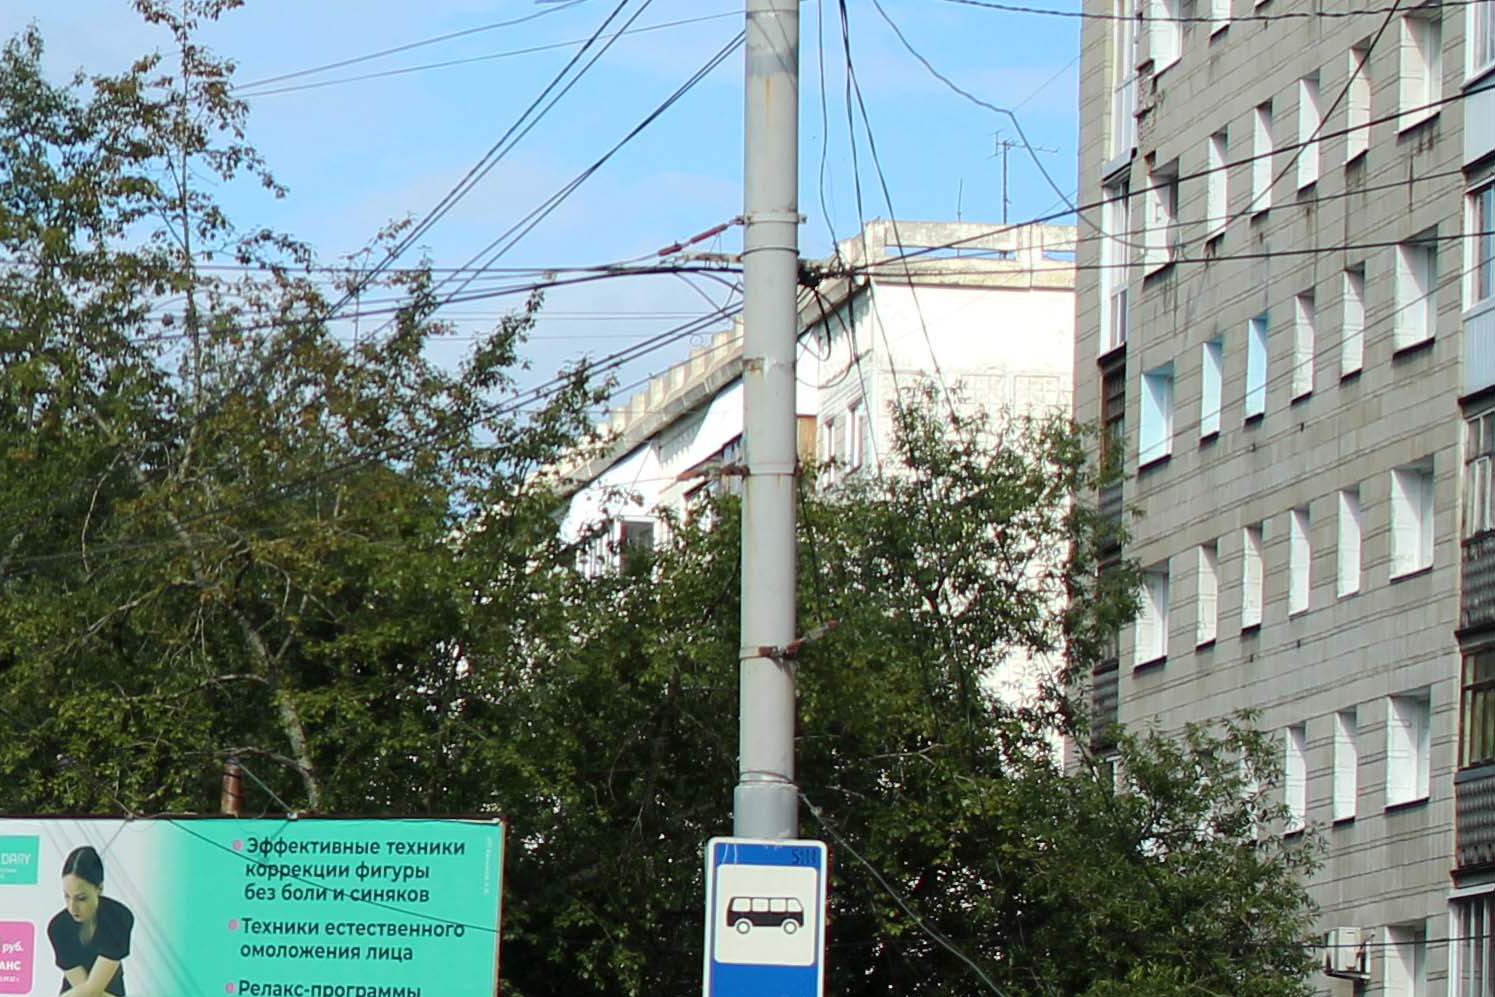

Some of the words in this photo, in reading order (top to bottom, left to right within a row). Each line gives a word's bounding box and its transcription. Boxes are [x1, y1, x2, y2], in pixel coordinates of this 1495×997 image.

[247, 837, 380, 856] Эффективные
[385, 841, 465, 855] техники
[246, 864, 349, 880] коррекции
[355, 862, 429, 882] фигуры
[244, 883, 275, 900] без
[281, 883, 327, 901] боли
[333, 888, 344, 901] и
[350, 888, 429, 902] синяков
[241, 918, 319, 935] Техники
[324, 922, 465, 938] естественного
[2, 941, 24, 953] руб.
[240, 944, 360, 959] омоложения
[366, 947, 413, 962] лица
